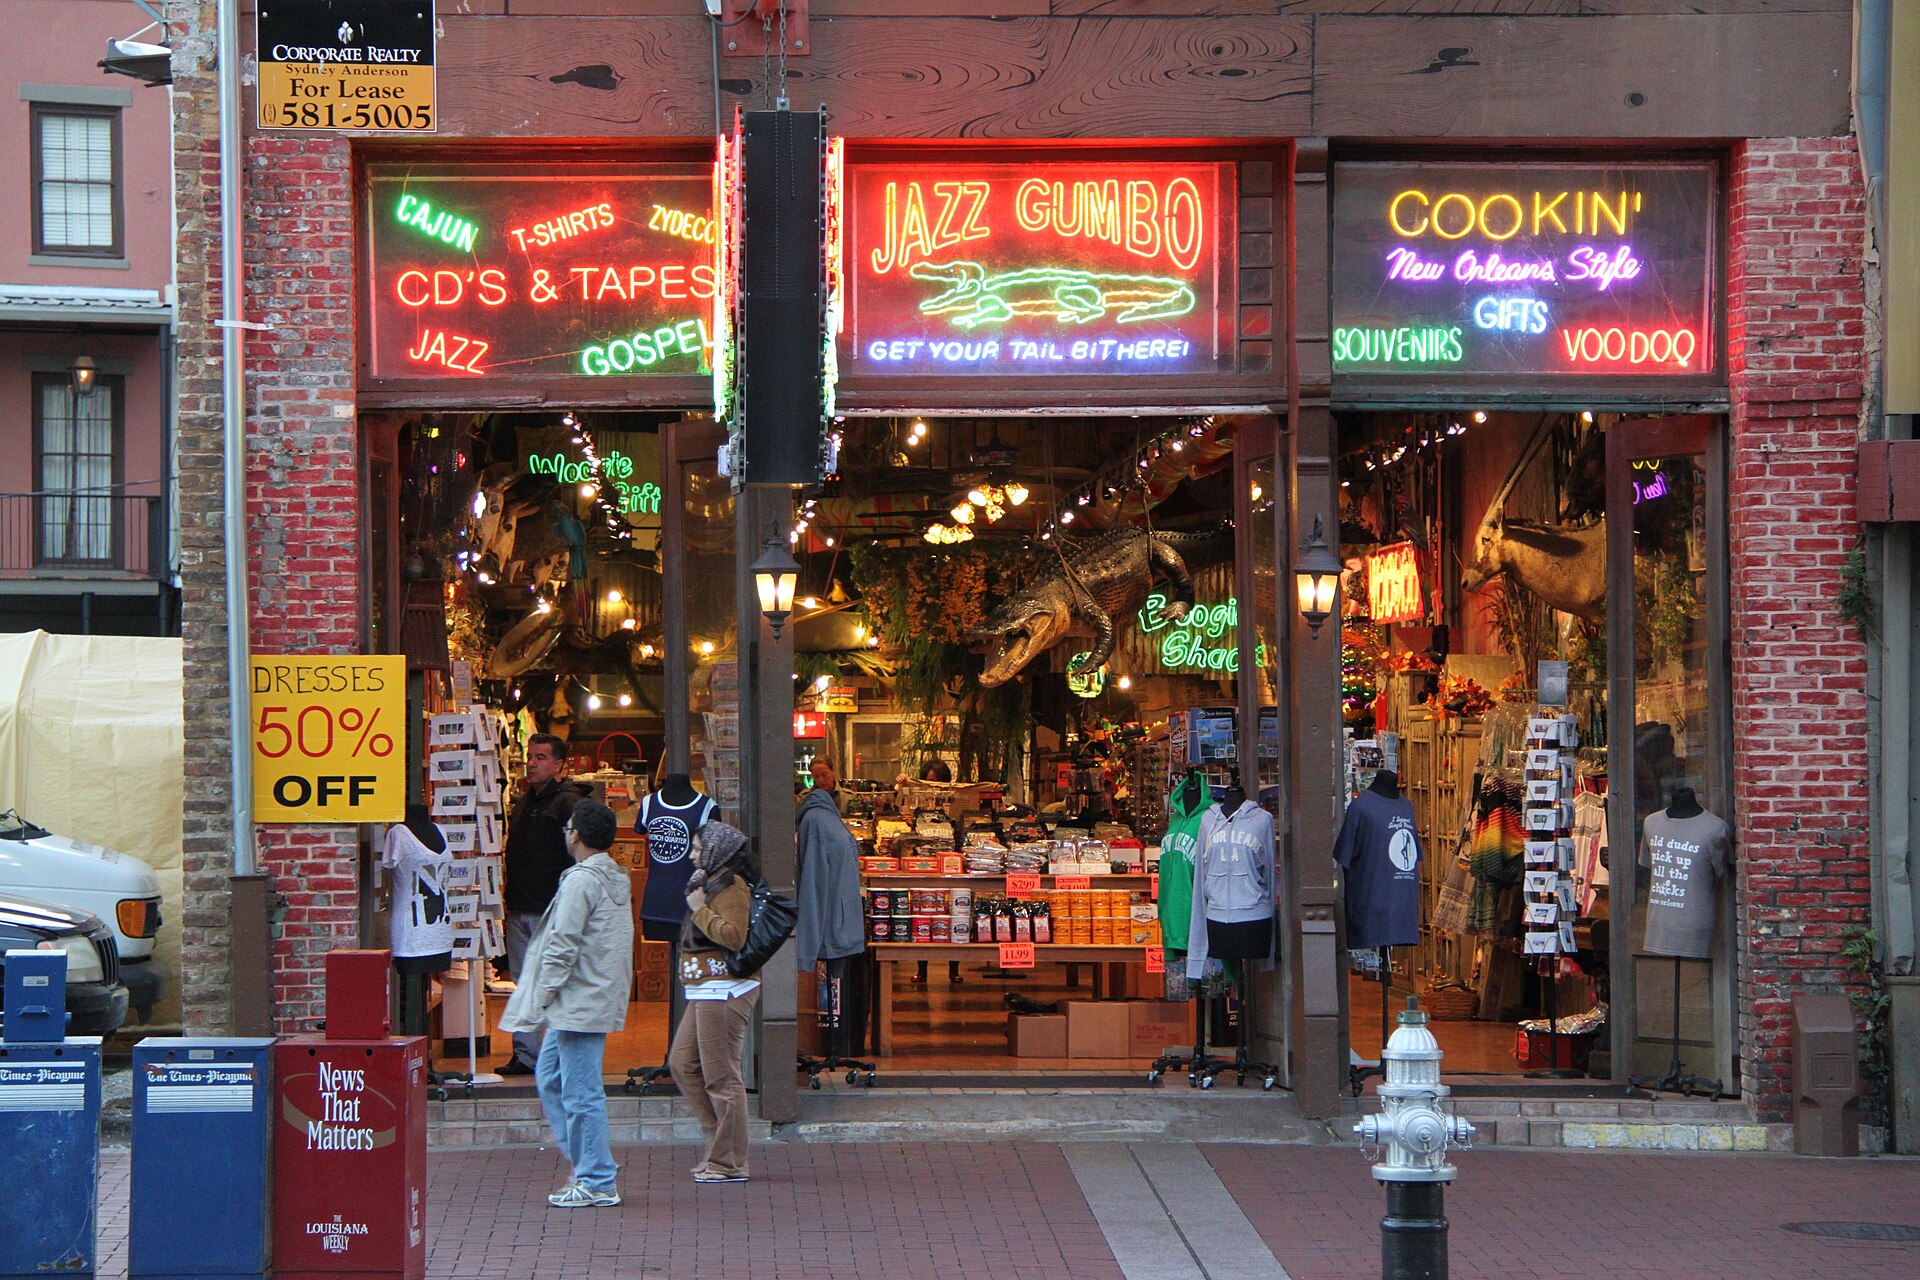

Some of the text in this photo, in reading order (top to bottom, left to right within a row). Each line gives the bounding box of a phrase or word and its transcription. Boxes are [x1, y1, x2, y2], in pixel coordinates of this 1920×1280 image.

[272, 44, 421, 62] CORPORATE REALTY
[285, 64, 409, 77] Sydney Anderson
[290, 78, 405, 99] For Lease
[280, 101, 431, 129] 581-5005
[396, 194, 478, 254] CAJUN
[510, 203, 615, 252] T-SHIRTS
[871, 177, 1203, 275] JAZZ GUMBO
[1389, 190, 1642, 240] COOKIN'
[1386, 245, 1645, 291] New Orleans Style
[396, 265, 717, 307] CD'S & TAPES
[1473, 297, 1548, 334] GIFTS
[409, 329, 489, 375] JAZZ
[580, 318, 717, 377] GOSPEL
[870, 339, 924, 361] GET
[928, 340, 999, 362] YOUR
[1333, 327, 1463, 362] SOUVENIRS
[1562, 328, 1696, 366] VOODOO
[253, 665, 385, 694] DRESSES
[256, 705, 394, 758] 50%
[273, 775, 377, 808] OFF
[1649, 835, 1700, 854] old dudes
[1651, 849, 1692, 870] pick up
[1653, 865, 1689, 881] all the
[1004, 950, 1030, 960] 11.99
[319, 1062, 365, 1092] News
[322, 1092, 361, 1122] That
[307, 1121, 374, 1150] Matters
[306, 1223, 369, 1234] LOUISIANA
[323, 1235, 350, 1251] WEEKLY
